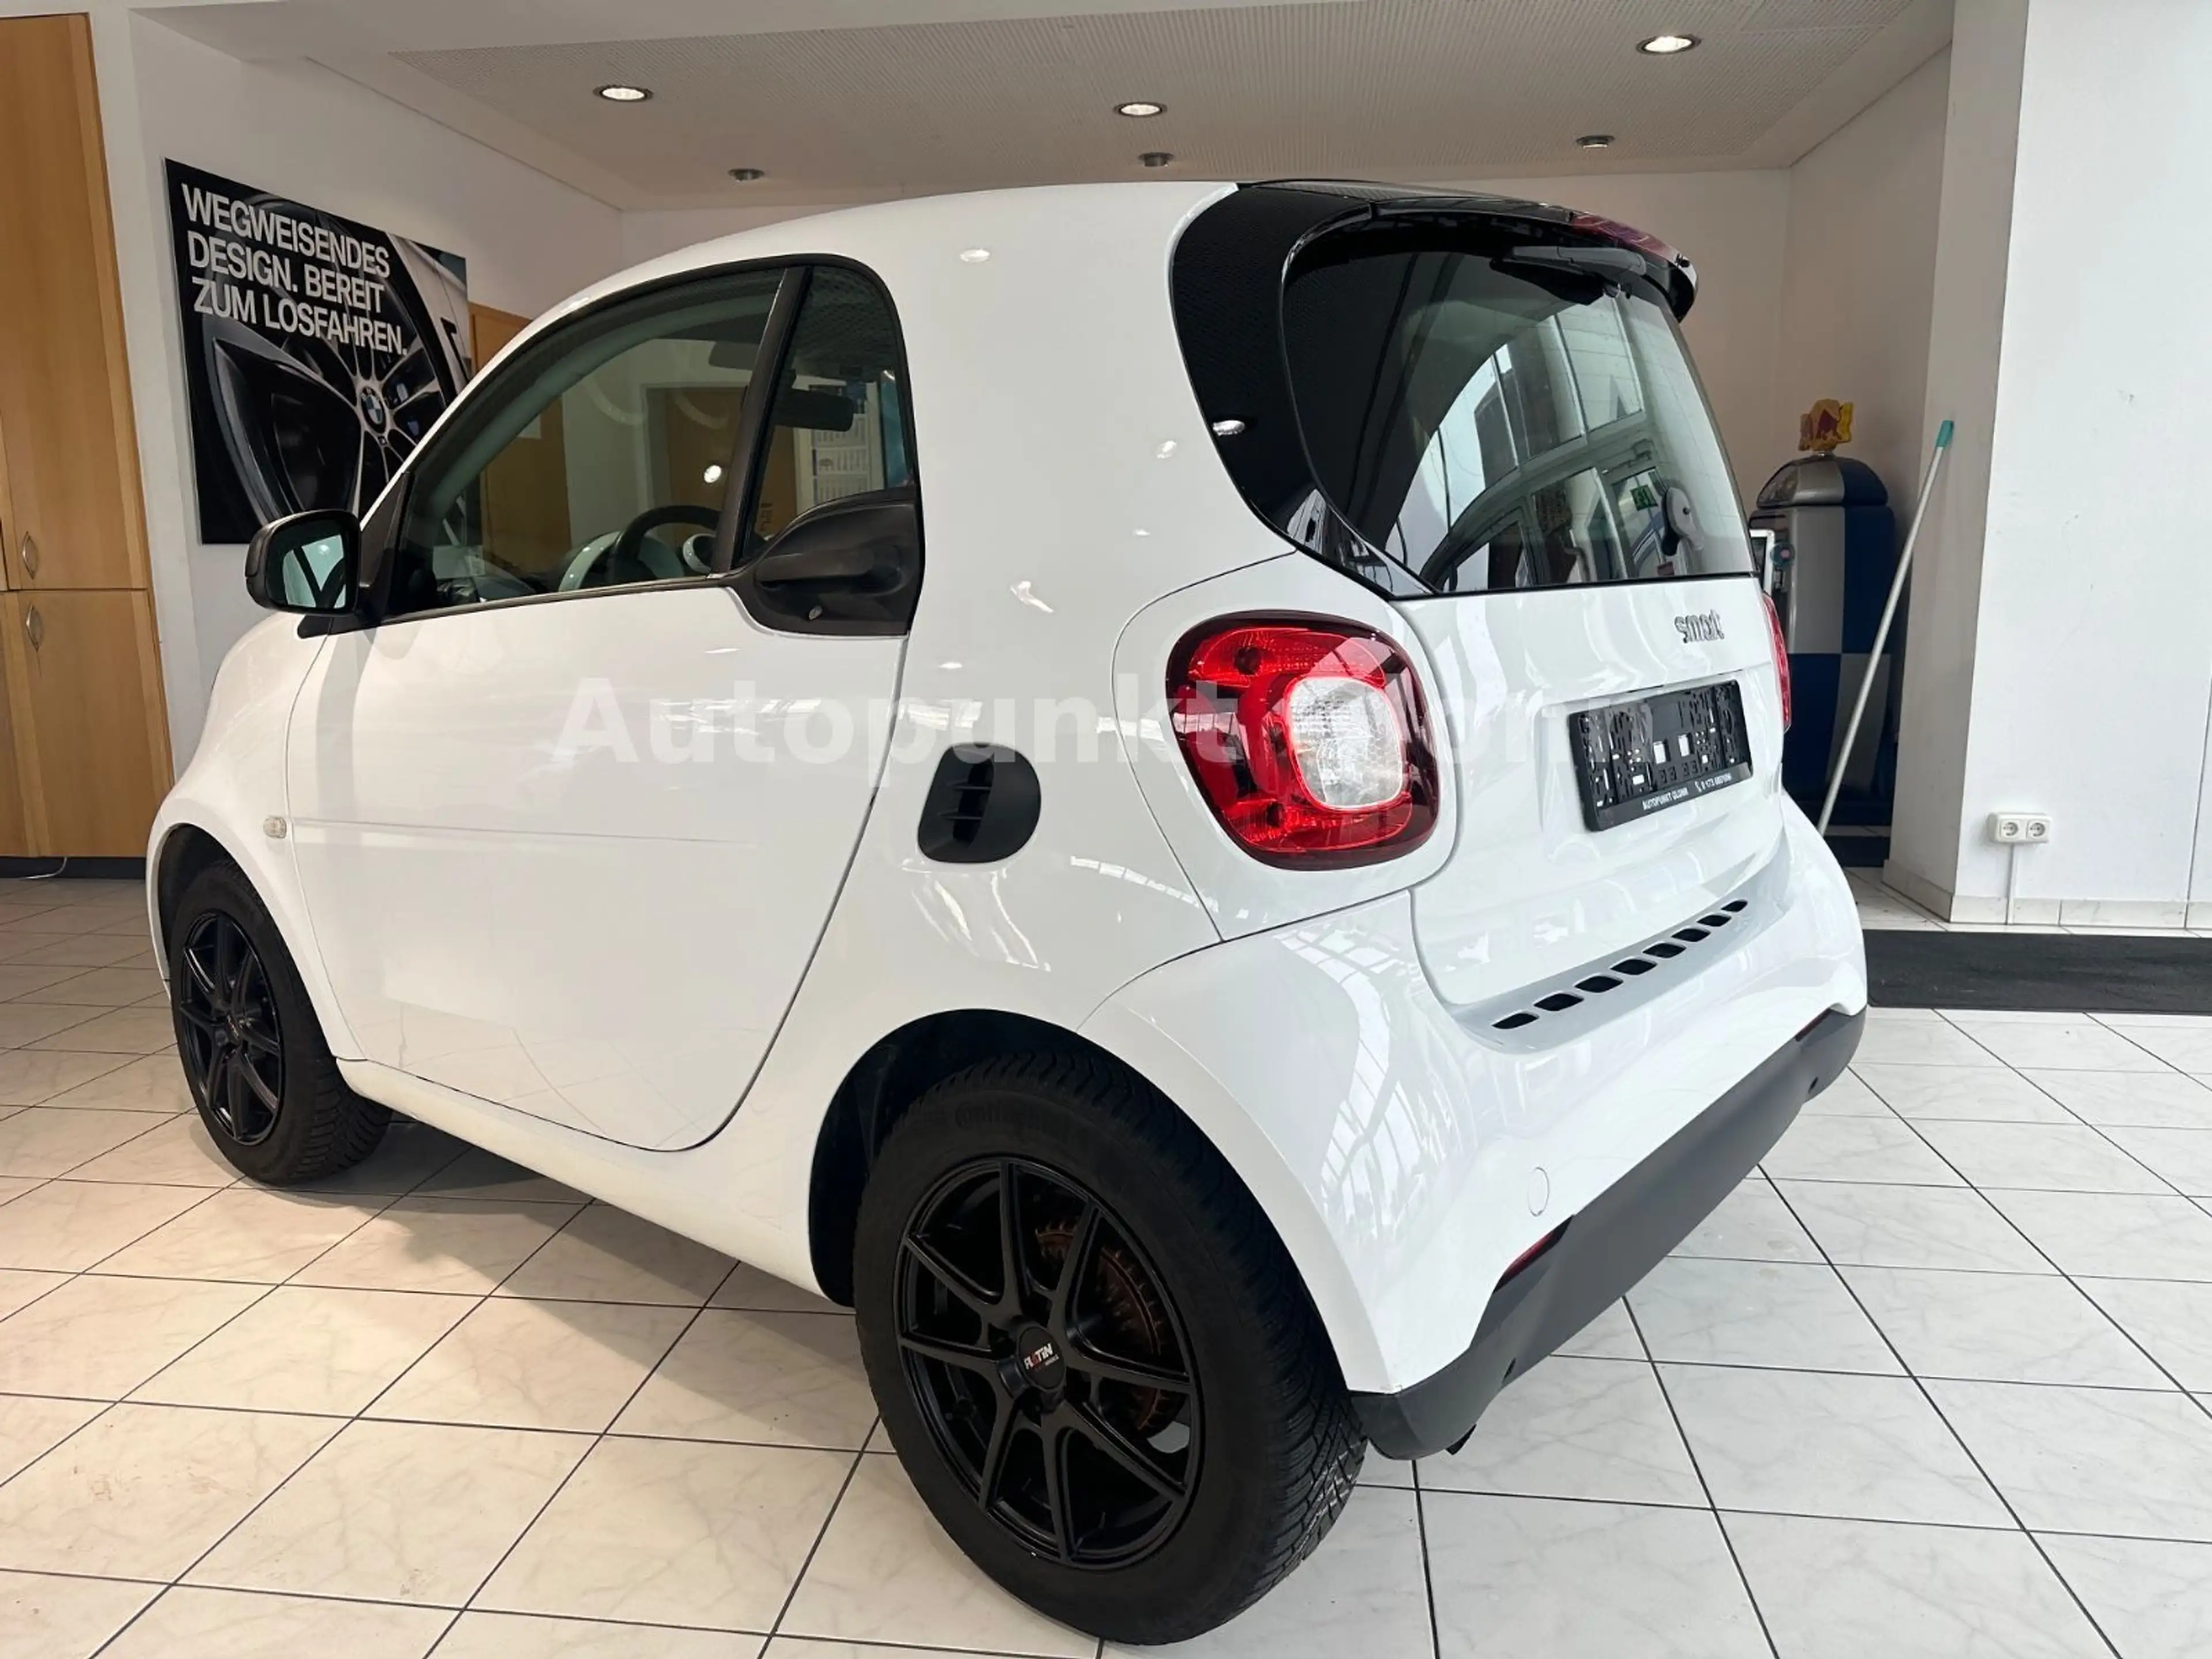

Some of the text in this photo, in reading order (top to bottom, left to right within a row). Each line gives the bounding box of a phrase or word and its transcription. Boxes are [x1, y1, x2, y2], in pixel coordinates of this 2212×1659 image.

[181, 183, 391, 278] WEGWEISENDES
[188, 230, 385, 313] DESIGN. BEREIT
[192, 276, 408, 355] ZUM LOSFAHREN.
